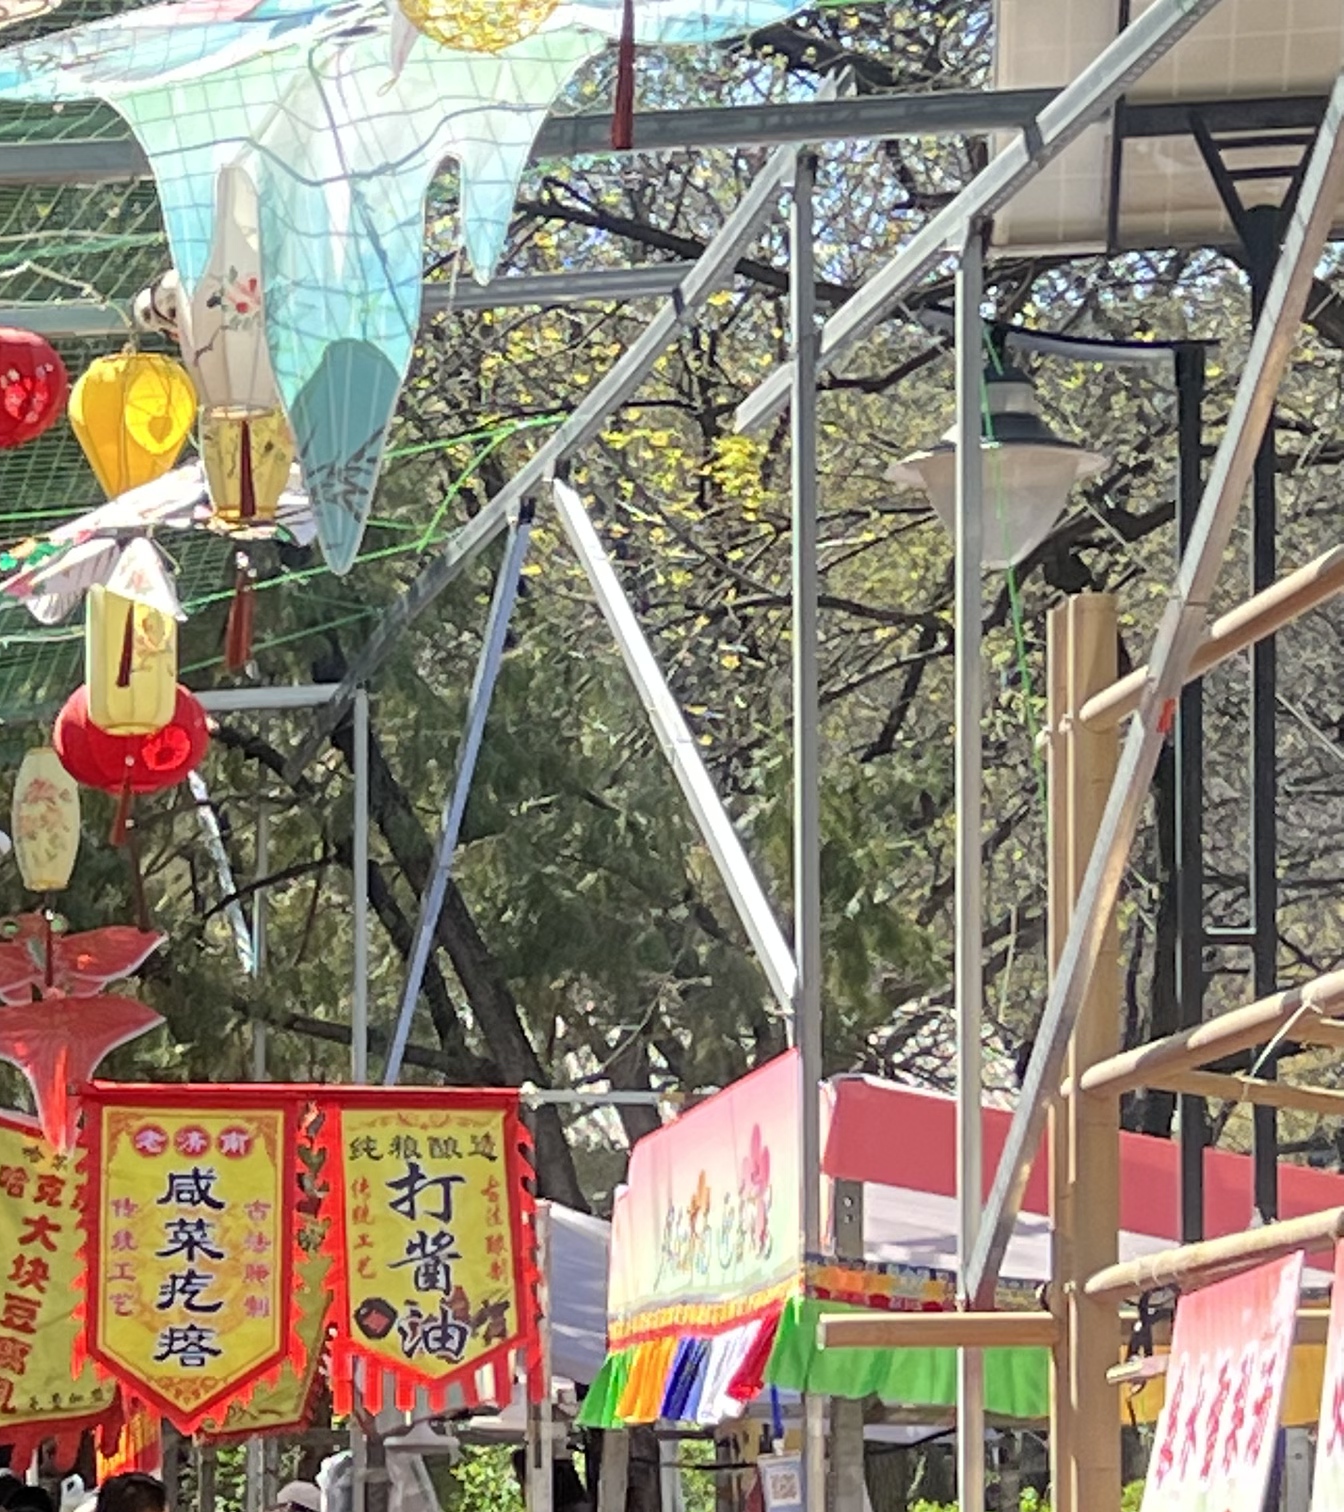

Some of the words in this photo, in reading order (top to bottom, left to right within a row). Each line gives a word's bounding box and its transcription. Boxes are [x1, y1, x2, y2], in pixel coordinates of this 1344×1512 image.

[134, 1130, 250, 1155] 老济南
[348, 1131, 498, 1162] 纯粮酿造
[154, 1166, 225, 1368] 咸菜疙瘩
